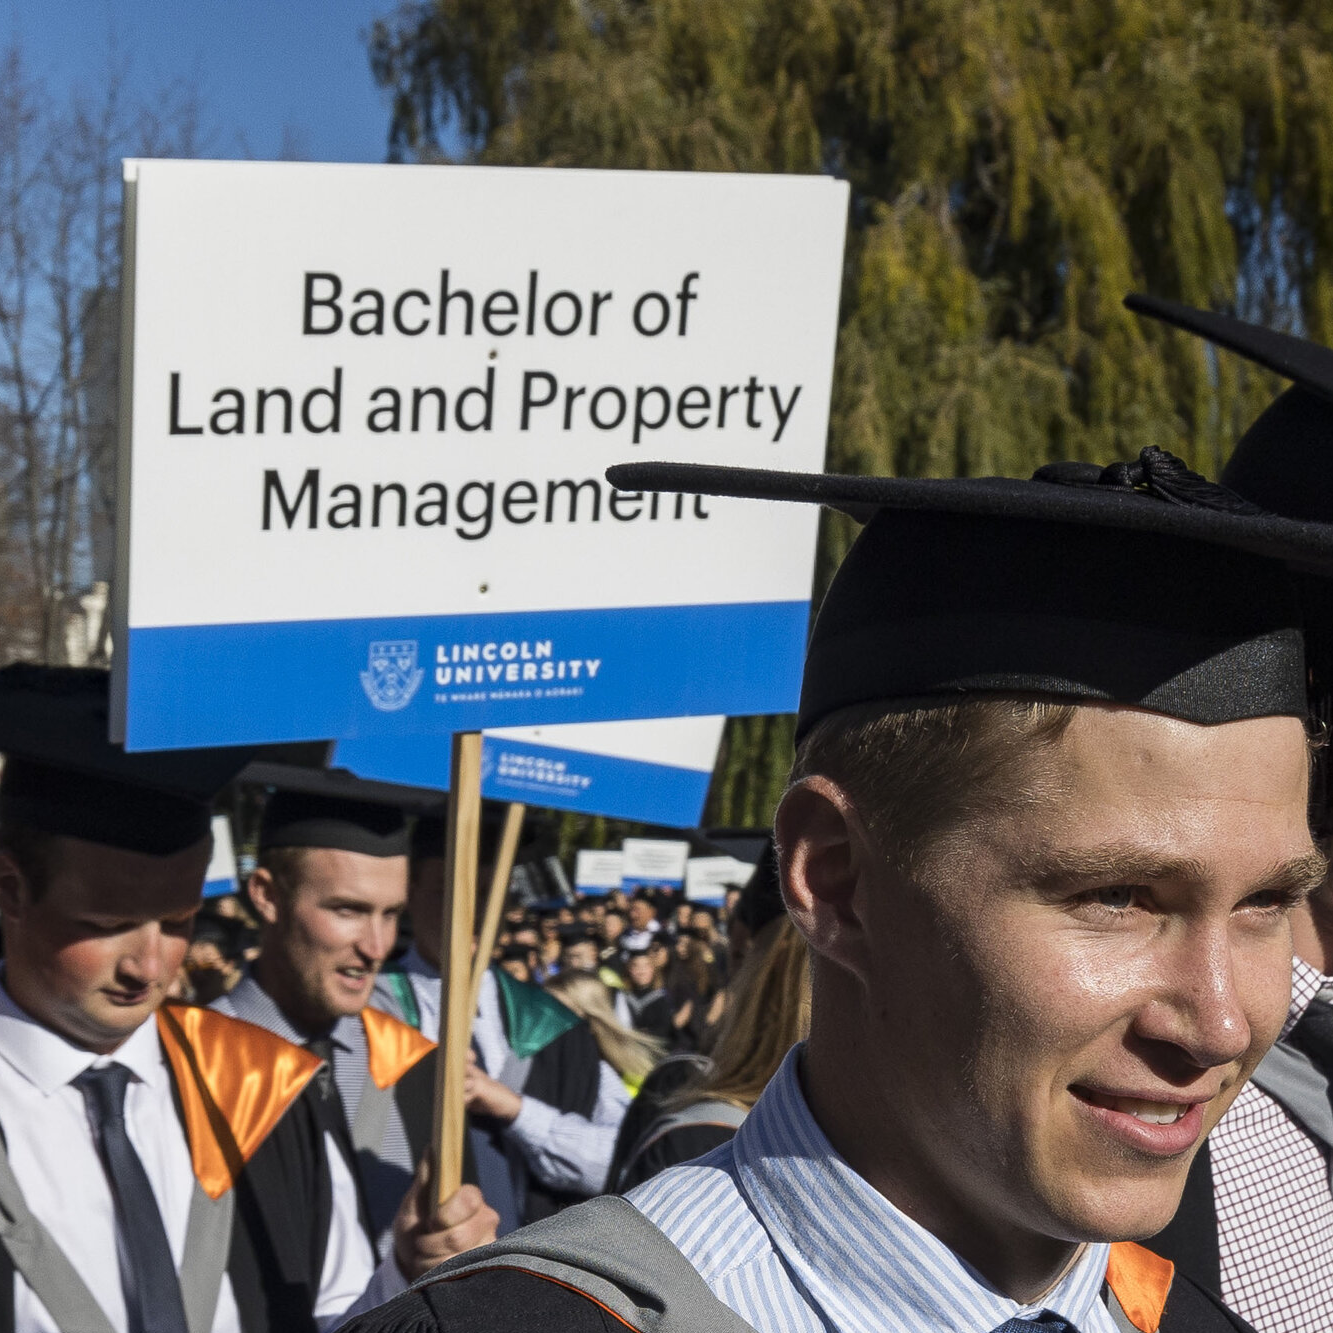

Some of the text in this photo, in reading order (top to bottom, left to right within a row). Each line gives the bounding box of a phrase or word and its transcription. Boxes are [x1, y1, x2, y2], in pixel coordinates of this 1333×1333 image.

[303, 269, 700, 337] Bachelor of
[169, 366, 803, 444] Land and Property
[436, 640, 553, 664] LINCOLN
[435, 659, 602, 686] UNIVERSITY
[499, 753, 566, 773] LINCOLN
[498, 765, 592, 788] UNIVERSITY
